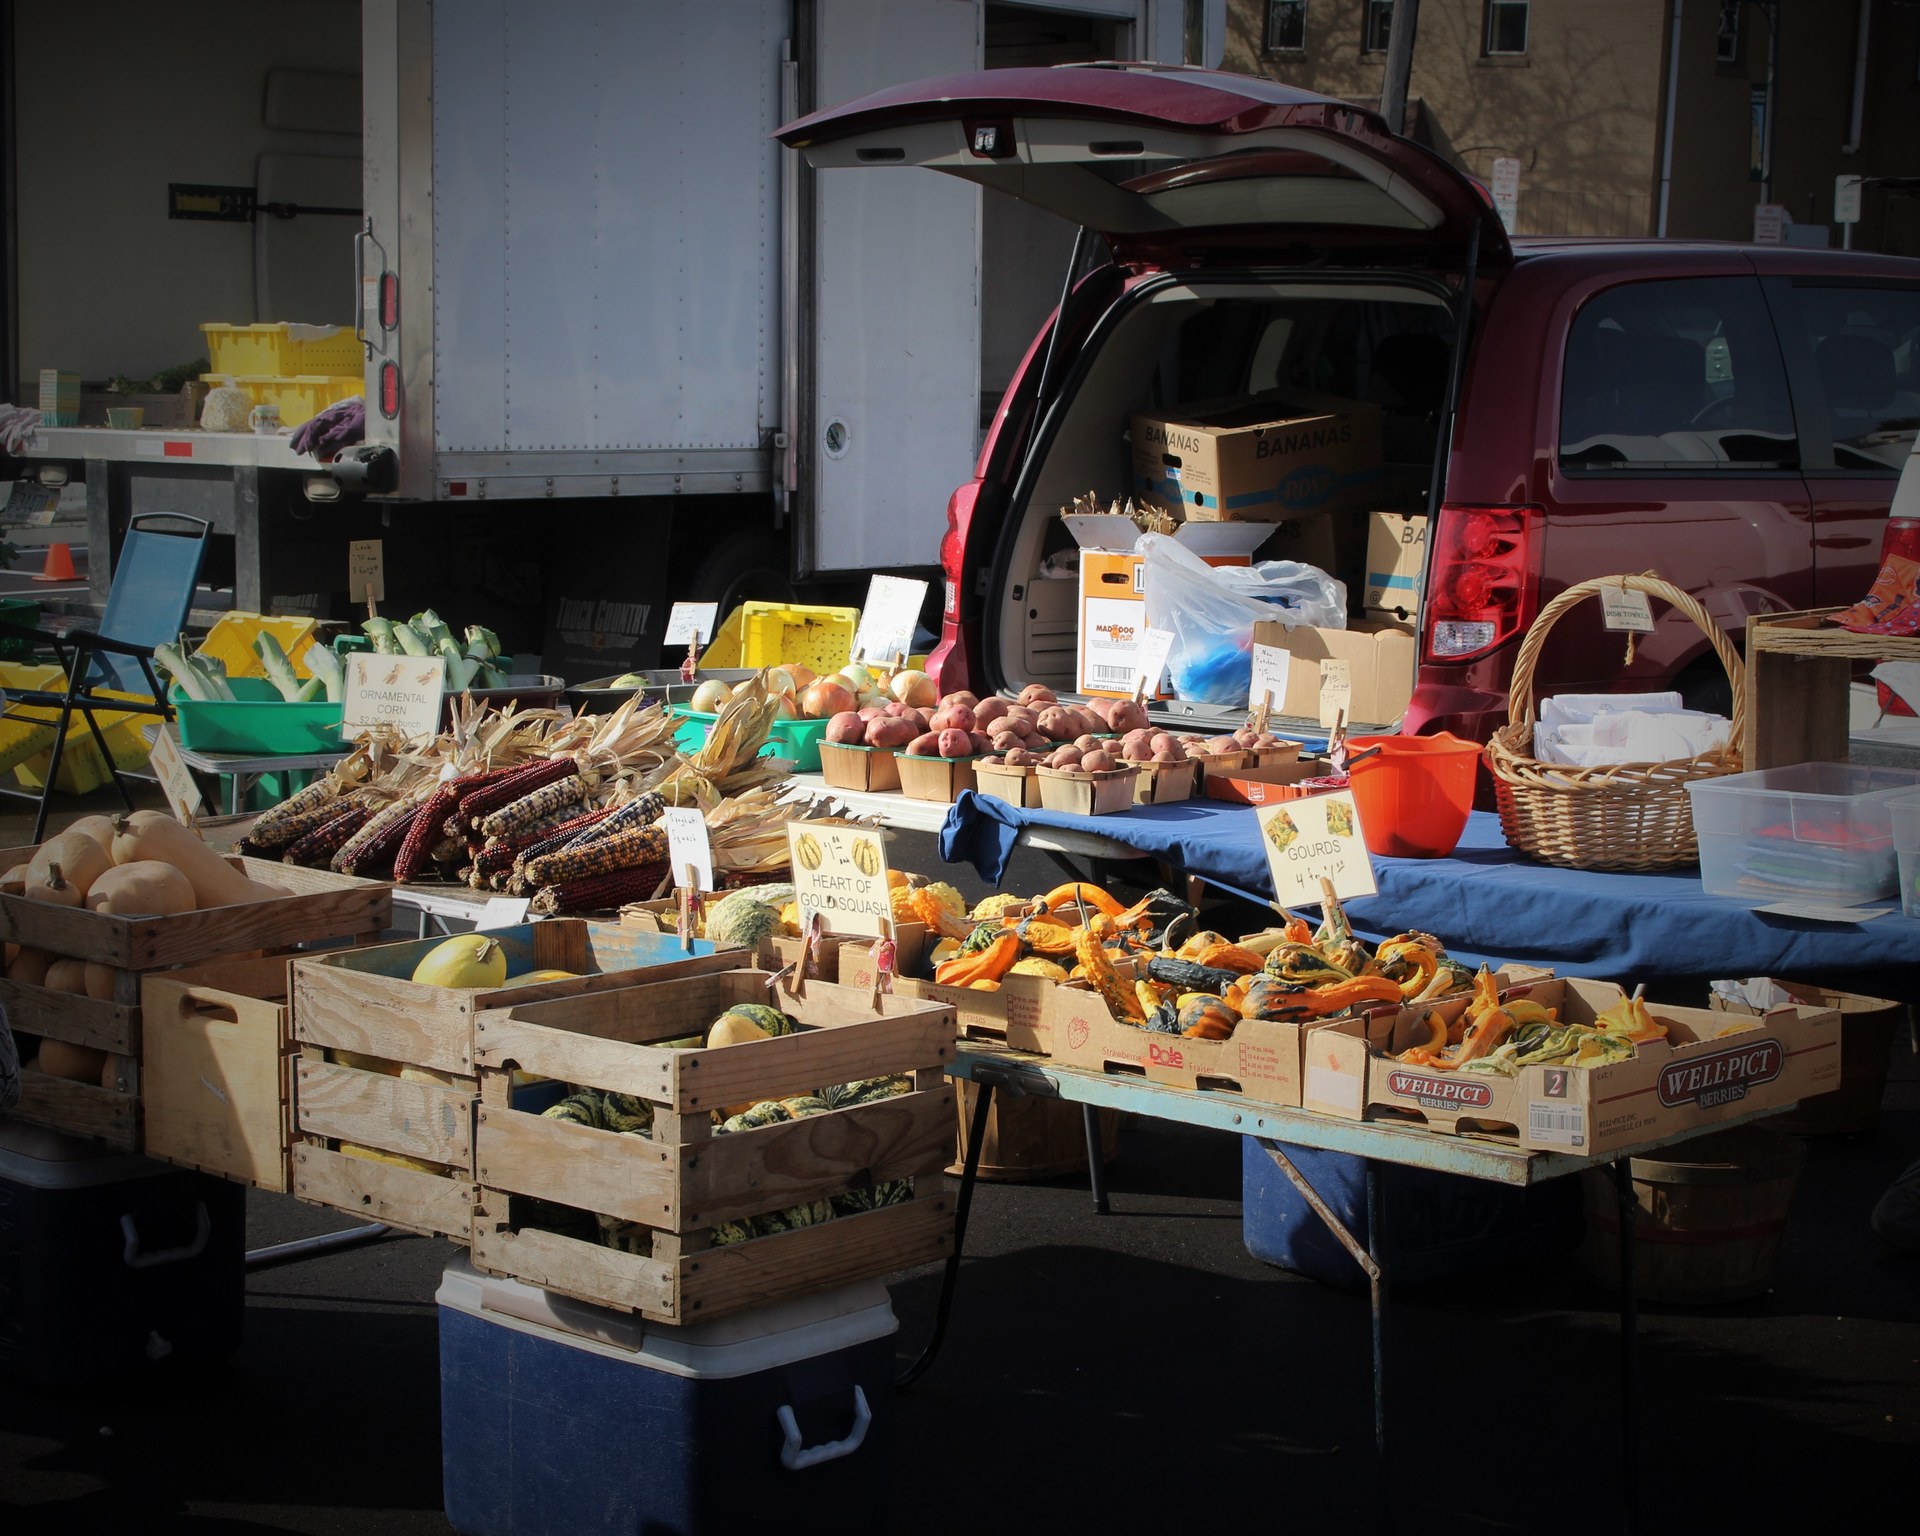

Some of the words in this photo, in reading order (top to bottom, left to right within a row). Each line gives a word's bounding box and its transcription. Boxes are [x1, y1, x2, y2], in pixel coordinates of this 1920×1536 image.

[1145, 426, 1200, 453] BANANAS
[1256, 425, 1352, 460] BANANAS
[594, 600, 651, 636] COUNTRY
[1624, 611, 1650, 620] TOWELS
[1096, 624, 1113, 633] MAD
[1118, 626, 1135, 635] DOG
[360, 690, 427, 704] ORNAMENTAL
[377, 704, 407, 715] CORN
[1288, 839, 1342, 861] GOURDS
[812, 874, 853, 891] HEART
[856, 879, 872, 894] OF
[1296, 873, 1305, 889] 4
[800, 892, 836, 909] GOLD
[839, 896, 889, 917] SQUASH
[1103, 1046, 1147, 1063] Strawberrie
[1149, 1043, 1184, 1069] Dole
[1189, 1062, 1215, 1074] Fraises
[1548, 1072, 1563, 1095] 2
[1419, 1097, 1459, 1111] BERRIES
[1701, 1084, 1745, 1108] BERRIES
